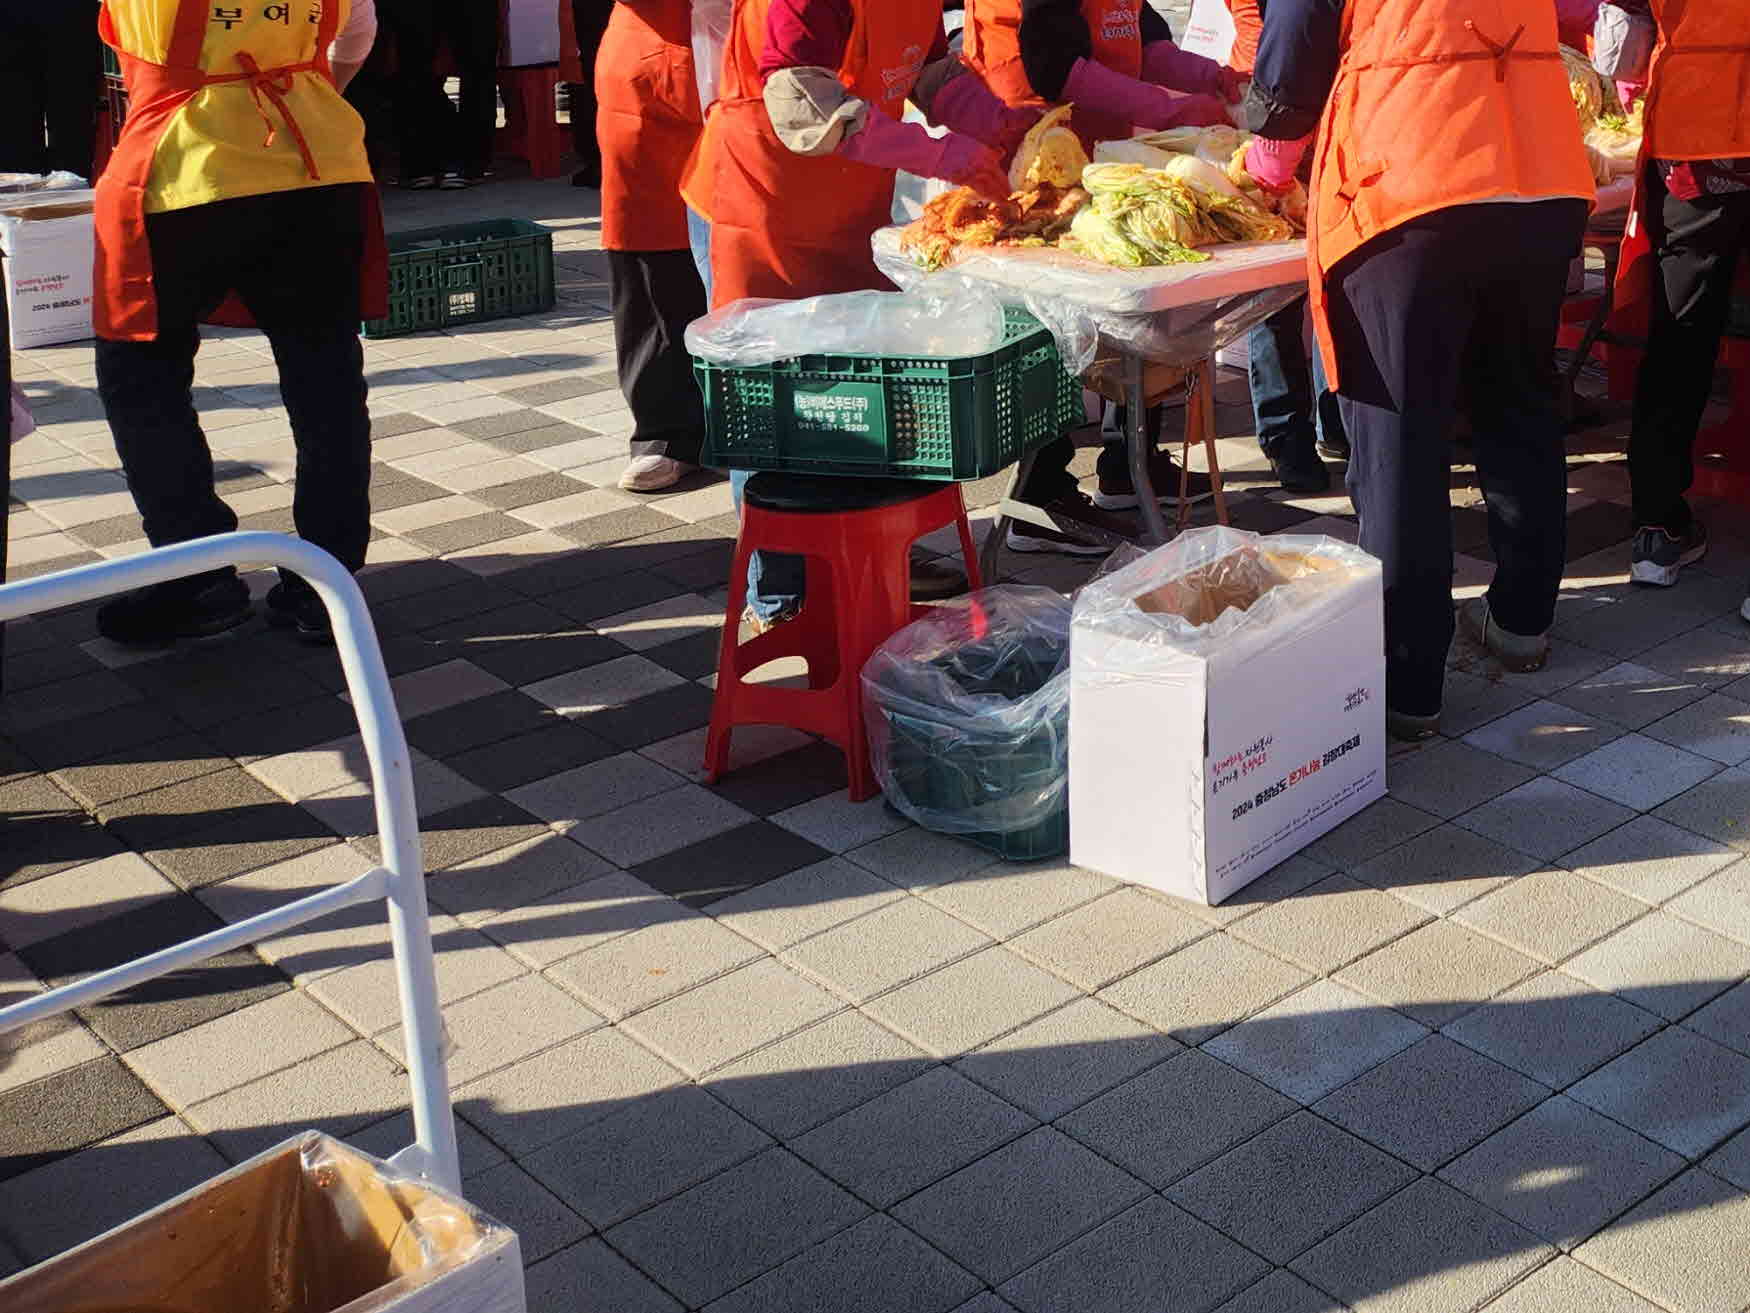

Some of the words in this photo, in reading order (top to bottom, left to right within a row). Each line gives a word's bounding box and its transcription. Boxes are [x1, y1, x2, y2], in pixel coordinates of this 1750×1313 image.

[1231, 799, 1253, 820] 2024
[1254, 778, 1289, 809] 충청남도
[1288, 759, 1322, 786] 온기나눔
[1321, 734, 1361, 768] 김장대축제
